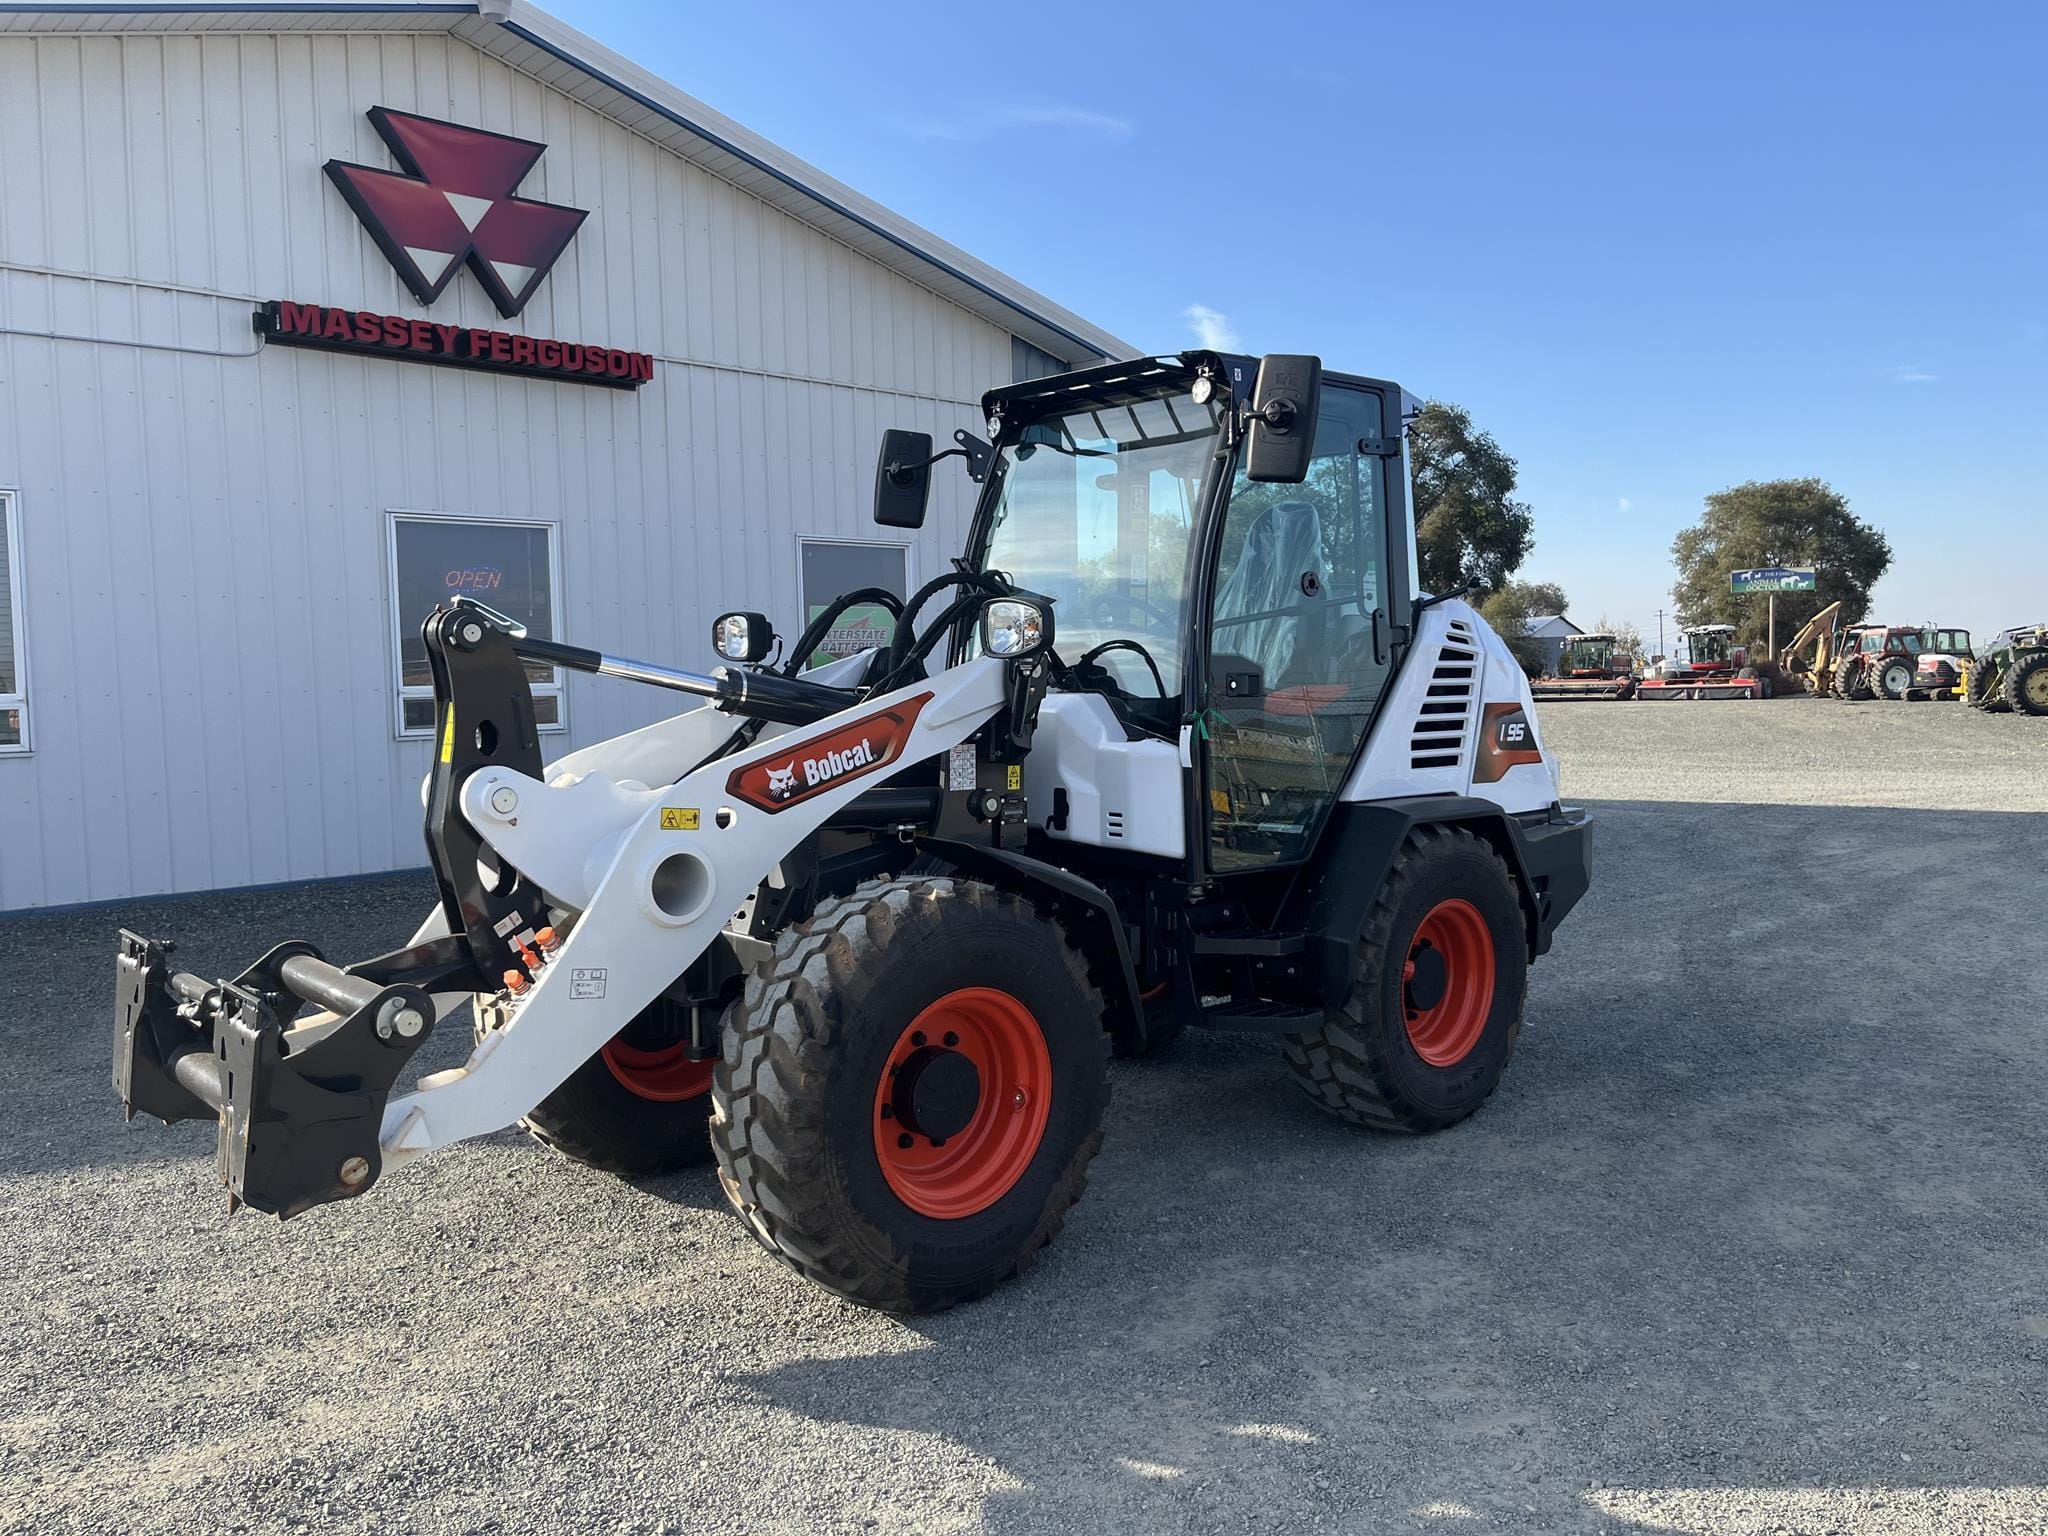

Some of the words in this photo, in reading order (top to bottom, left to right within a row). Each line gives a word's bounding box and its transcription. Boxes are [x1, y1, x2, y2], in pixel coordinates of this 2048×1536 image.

[280, 300, 459, 354] MASSEY
[468, 327, 654, 381] FERGUSON
[445, 570, 502, 588] OPEN
[1745, 584, 1780, 592] DOCTOR
[826, 629, 887, 640] NTERSTATE
[802, 738, 874, 788] Bobcat
